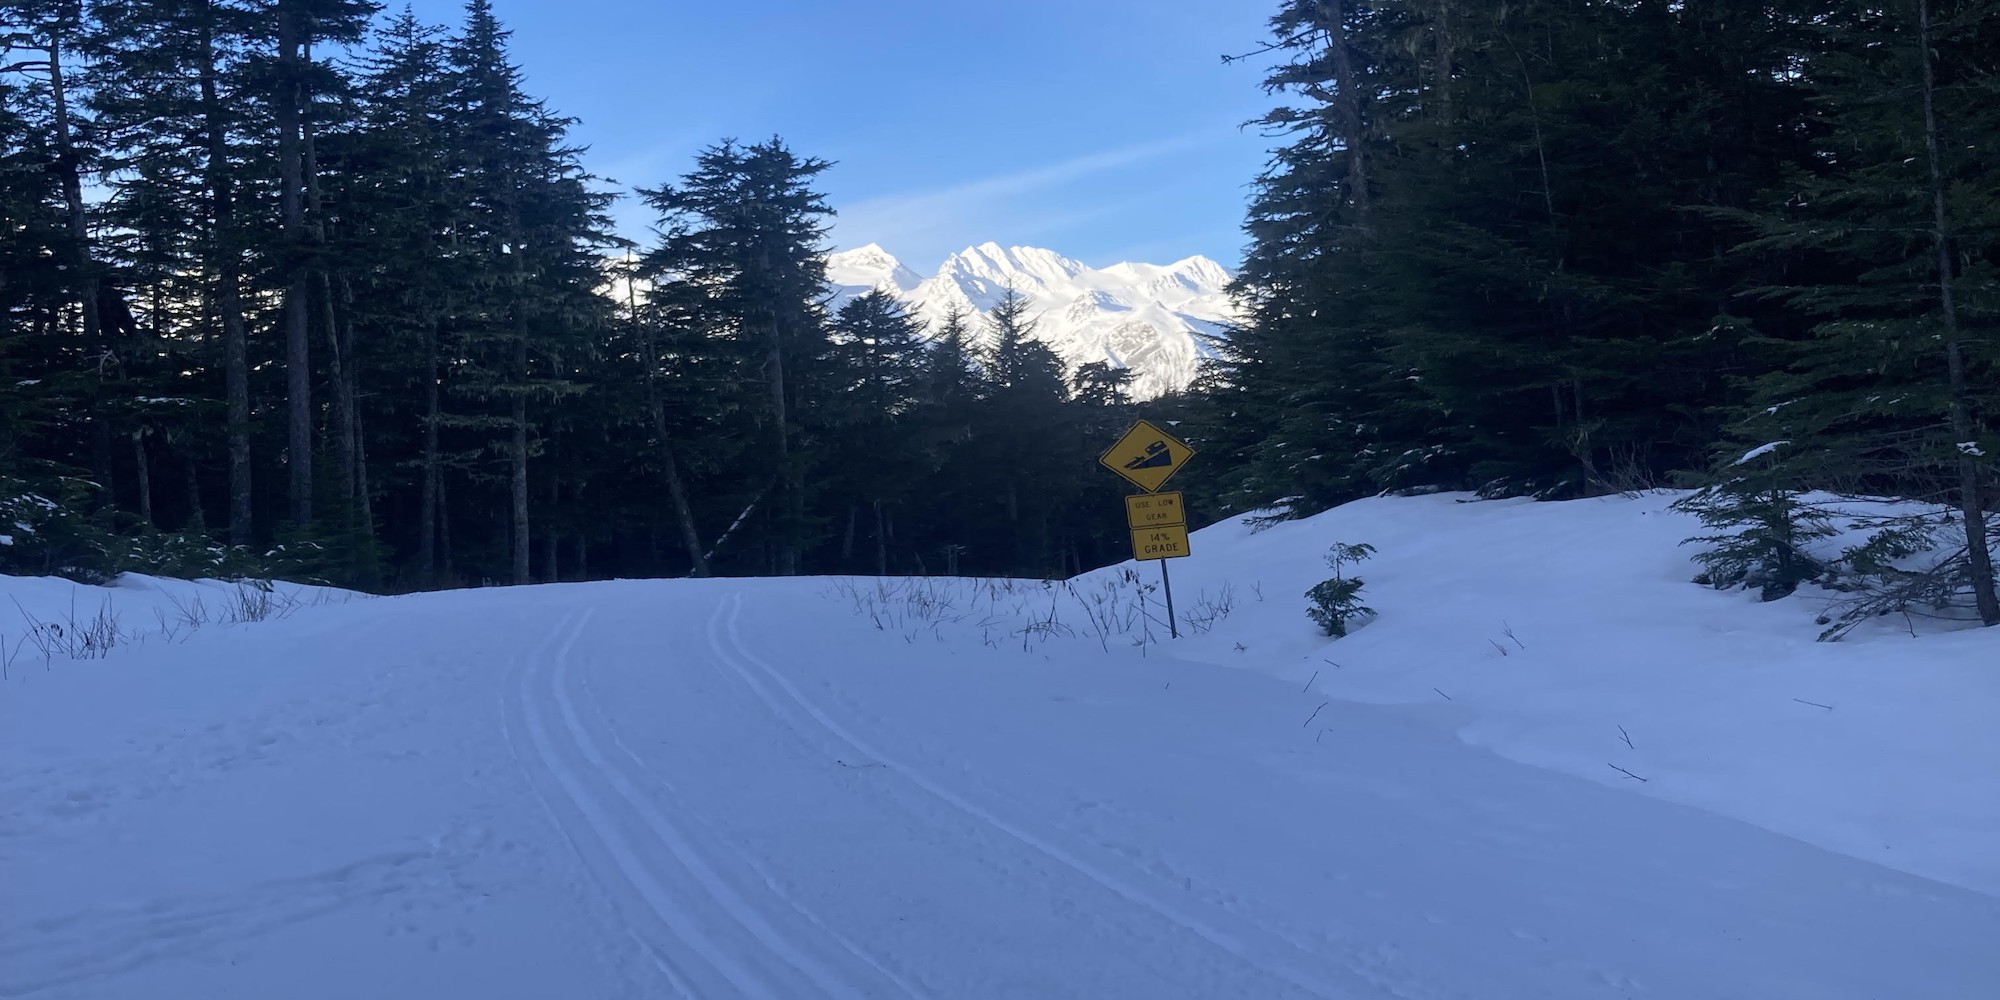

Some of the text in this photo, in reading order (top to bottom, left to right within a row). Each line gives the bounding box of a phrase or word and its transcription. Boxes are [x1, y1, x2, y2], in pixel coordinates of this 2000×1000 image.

[1135, 499, 1174, 509] USE LOW
[1146, 512, 1167, 520] GEAR
[1150, 533, 1170, 541] 14%
[1144, 543, 1179, 553] GRADE
